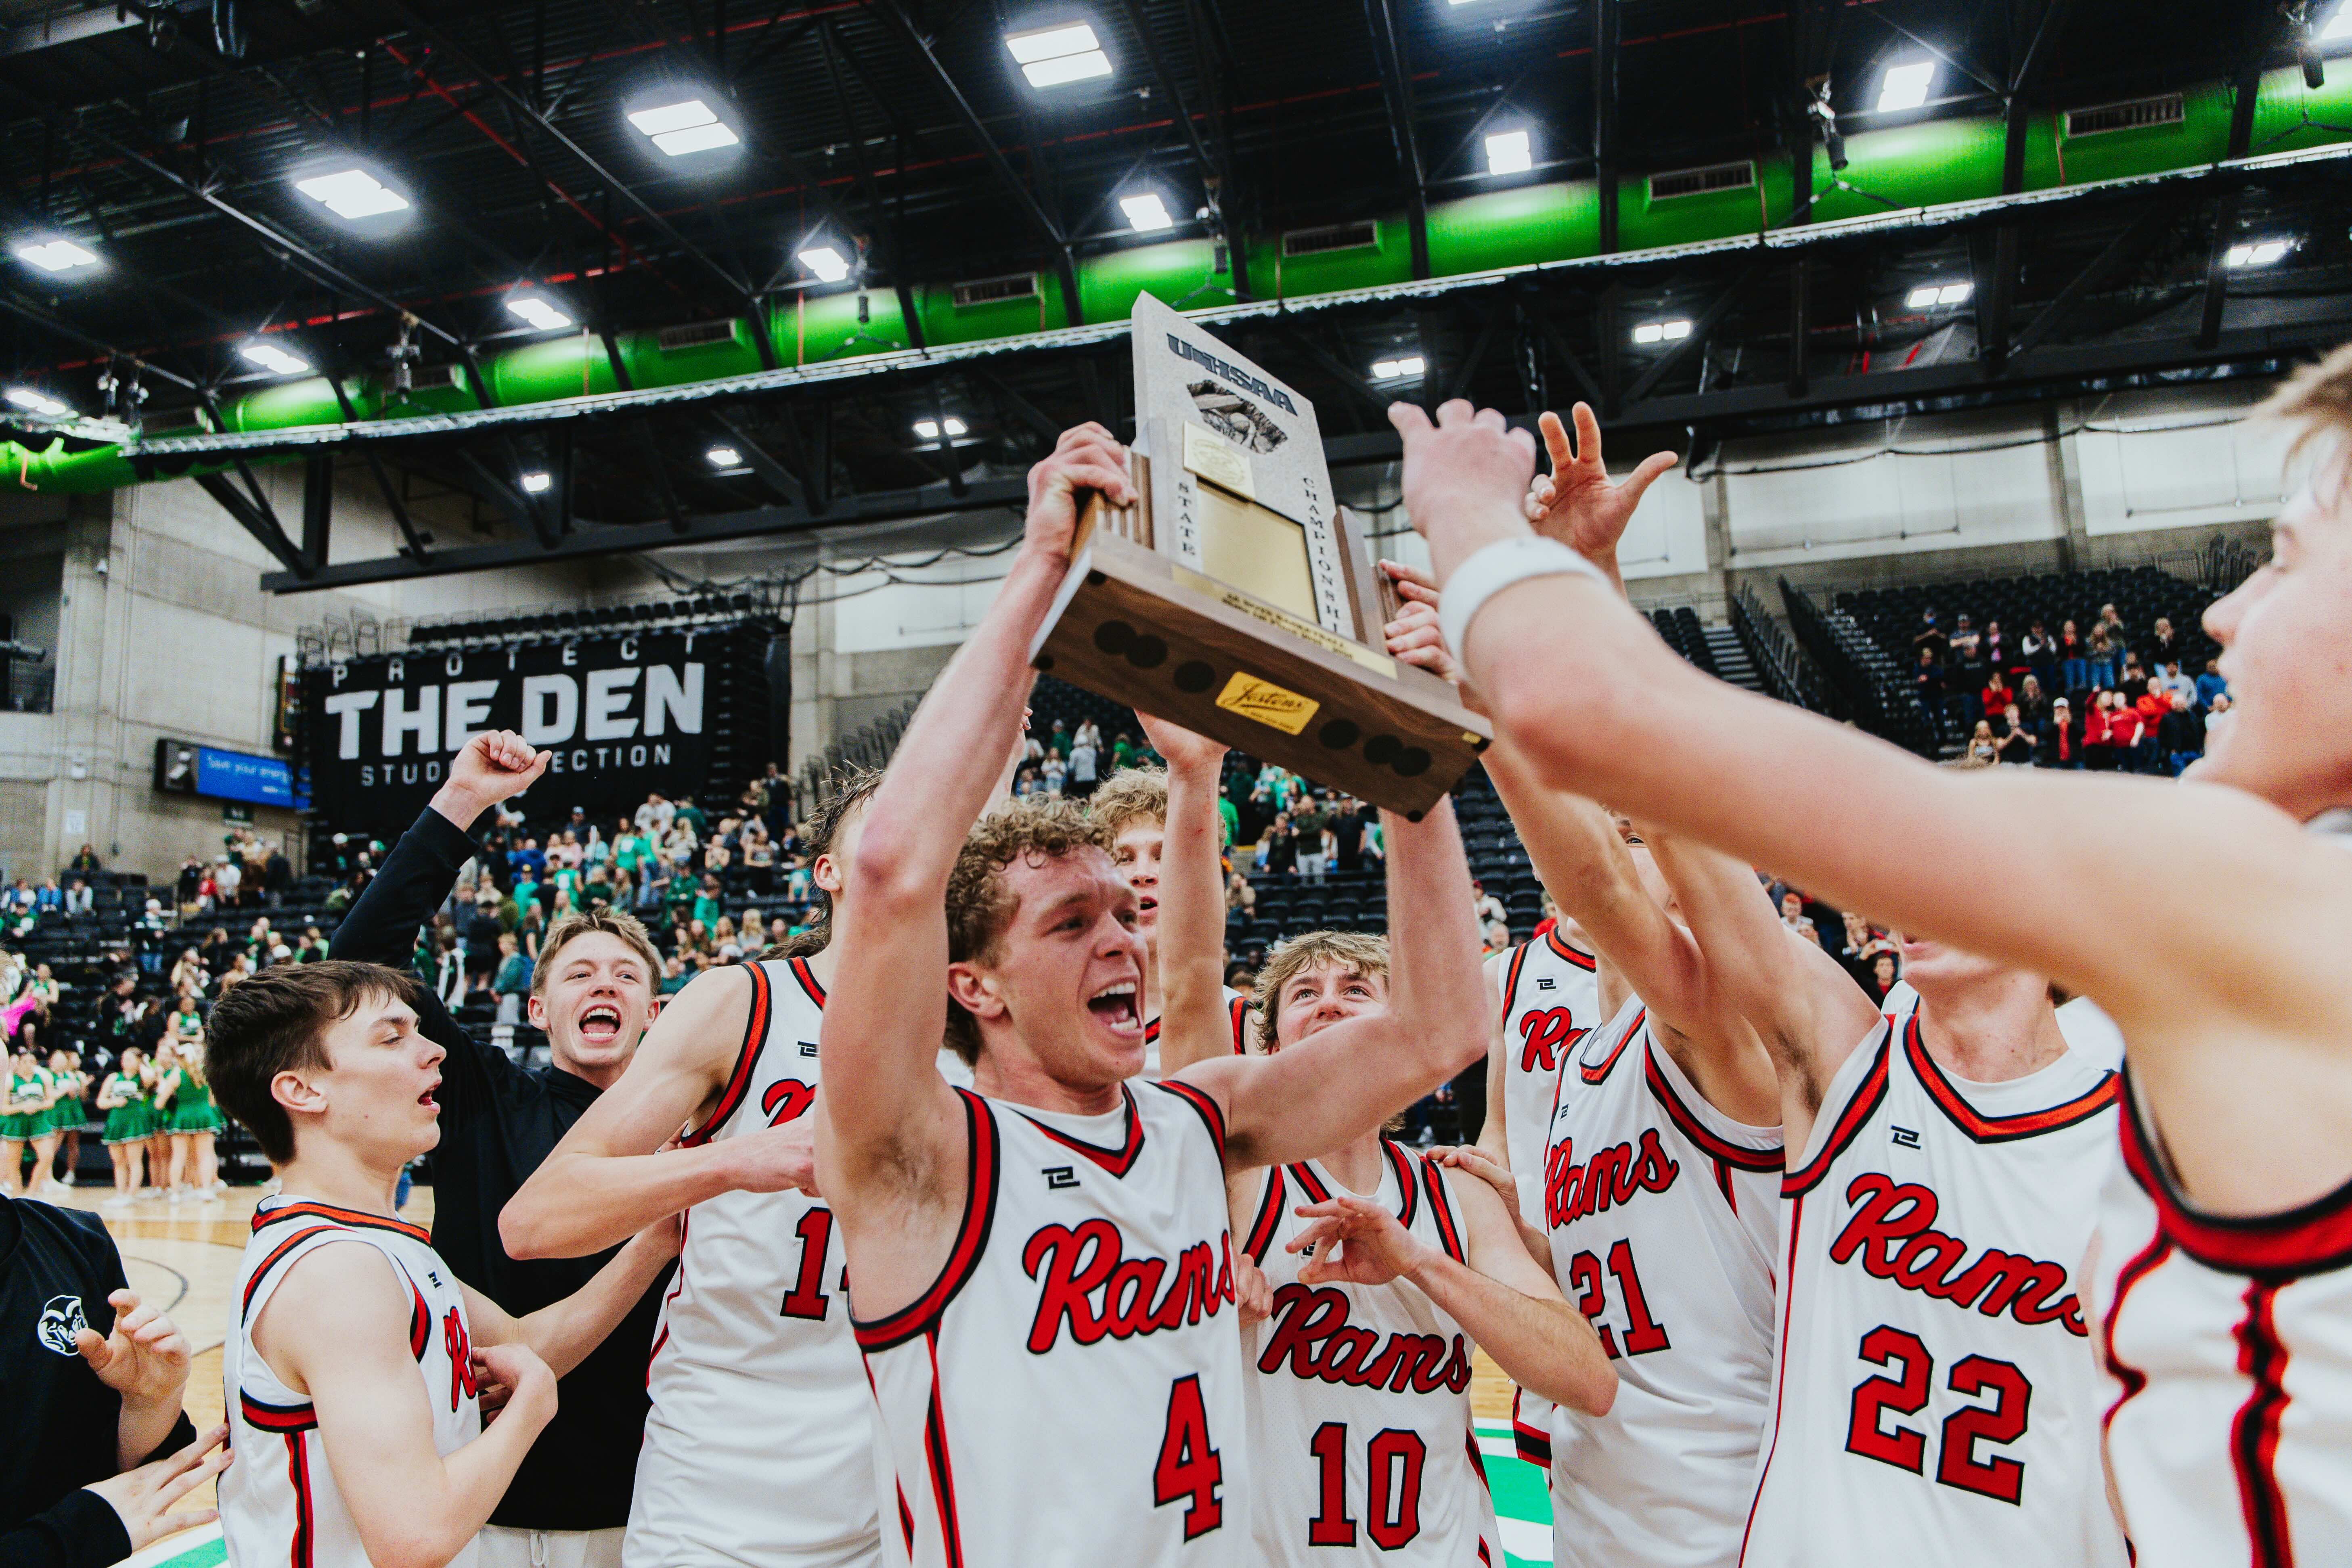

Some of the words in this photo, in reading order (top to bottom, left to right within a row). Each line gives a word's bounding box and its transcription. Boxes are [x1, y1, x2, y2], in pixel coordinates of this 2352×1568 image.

[1178, 482, 1196, 556] STATE
[1303, 477, 1340, 633] CHAMPIONSHI
[325, 679, 500, 759] THE
[522, 662, 705, 746] DEN
[332, 631, 697, 688] PROTECT
[361, 758, 453, 787] STUD
[551, 743, 671, 773] ECTION
[1545, 1128, 1680, 1235] Rams
[779, 1206, 850, 1322] 1
[1022, 1218, 1236, 1355] Rams
[1570, 1237, 1671, 1359] 21
[1257, 1283, 1472, 1394] Rams
[1153, 1372, 1223, 1543] 4
[1845, 1324, 2032, 1507] 22
[1309, 1421, 1427, 1551] 10
